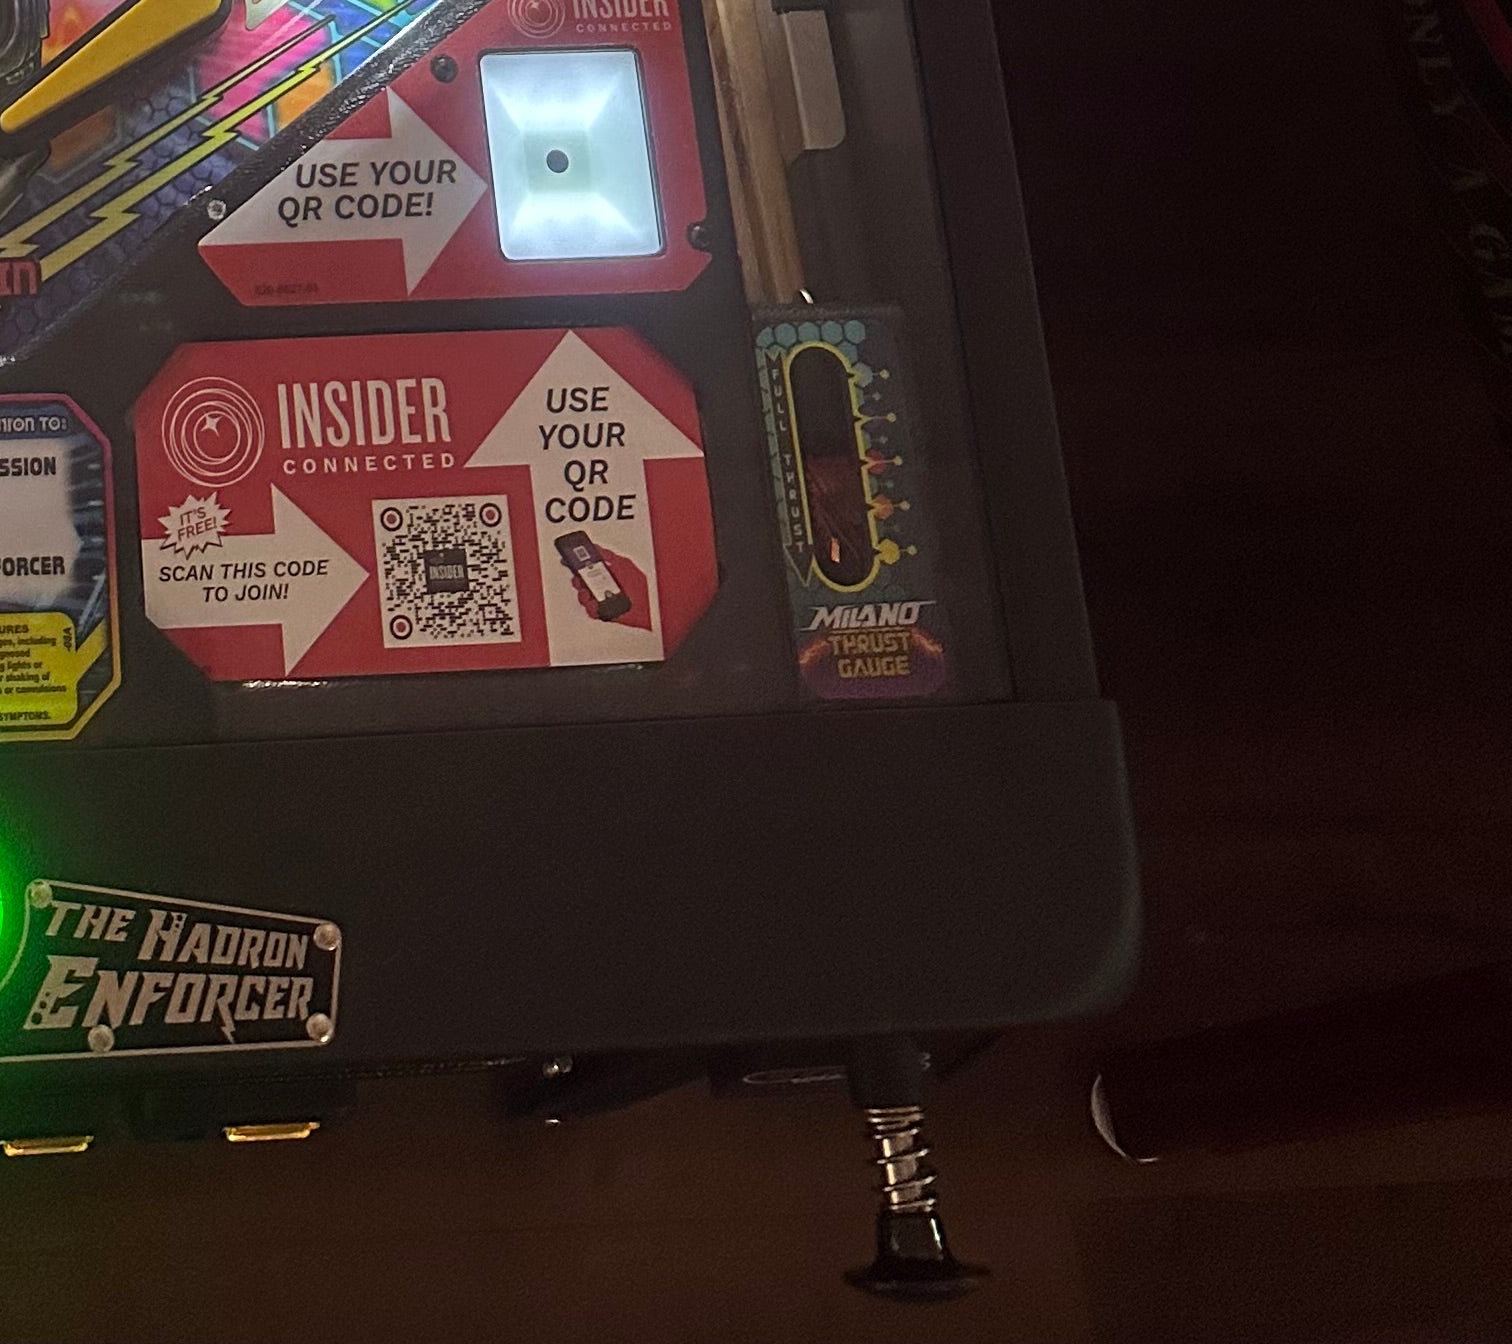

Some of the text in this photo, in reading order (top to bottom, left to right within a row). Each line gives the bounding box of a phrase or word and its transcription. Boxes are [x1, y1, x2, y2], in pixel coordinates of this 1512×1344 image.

[575, 20, 673, 33] CONNECTED
[295, 159, 457, 190] USE YOUR
[276, 191, 434, 227] QR CODE!
[277, 377, 452, 449] INSIDER
[546, 386, 610, 414] USE
[771, 368, 788, 432] FULL
[38, 415, 69, 432] TO:
[538, 421, 626, 451] YOUR
[282, 452, 455, 475] CONNECTED
[563, 458, 609, 492] QR
[179, 506, 206, 526] IT'S
[545, 493, 637, 524] CODE
[177, 517, 218, 542] FREE!
[158, 559, 330, 582] SCAN THIS CODE
[203, 583, 289, 602] TO JOIN!
[802, 600, 932, 632] MILANO
[828, 631, 911, 656] THRUST
[837, 654, 911, 679] GAUGE
[44, 898, 308, 970] THE HADRON
[23, 953, 316, 1049] ENFORCER
